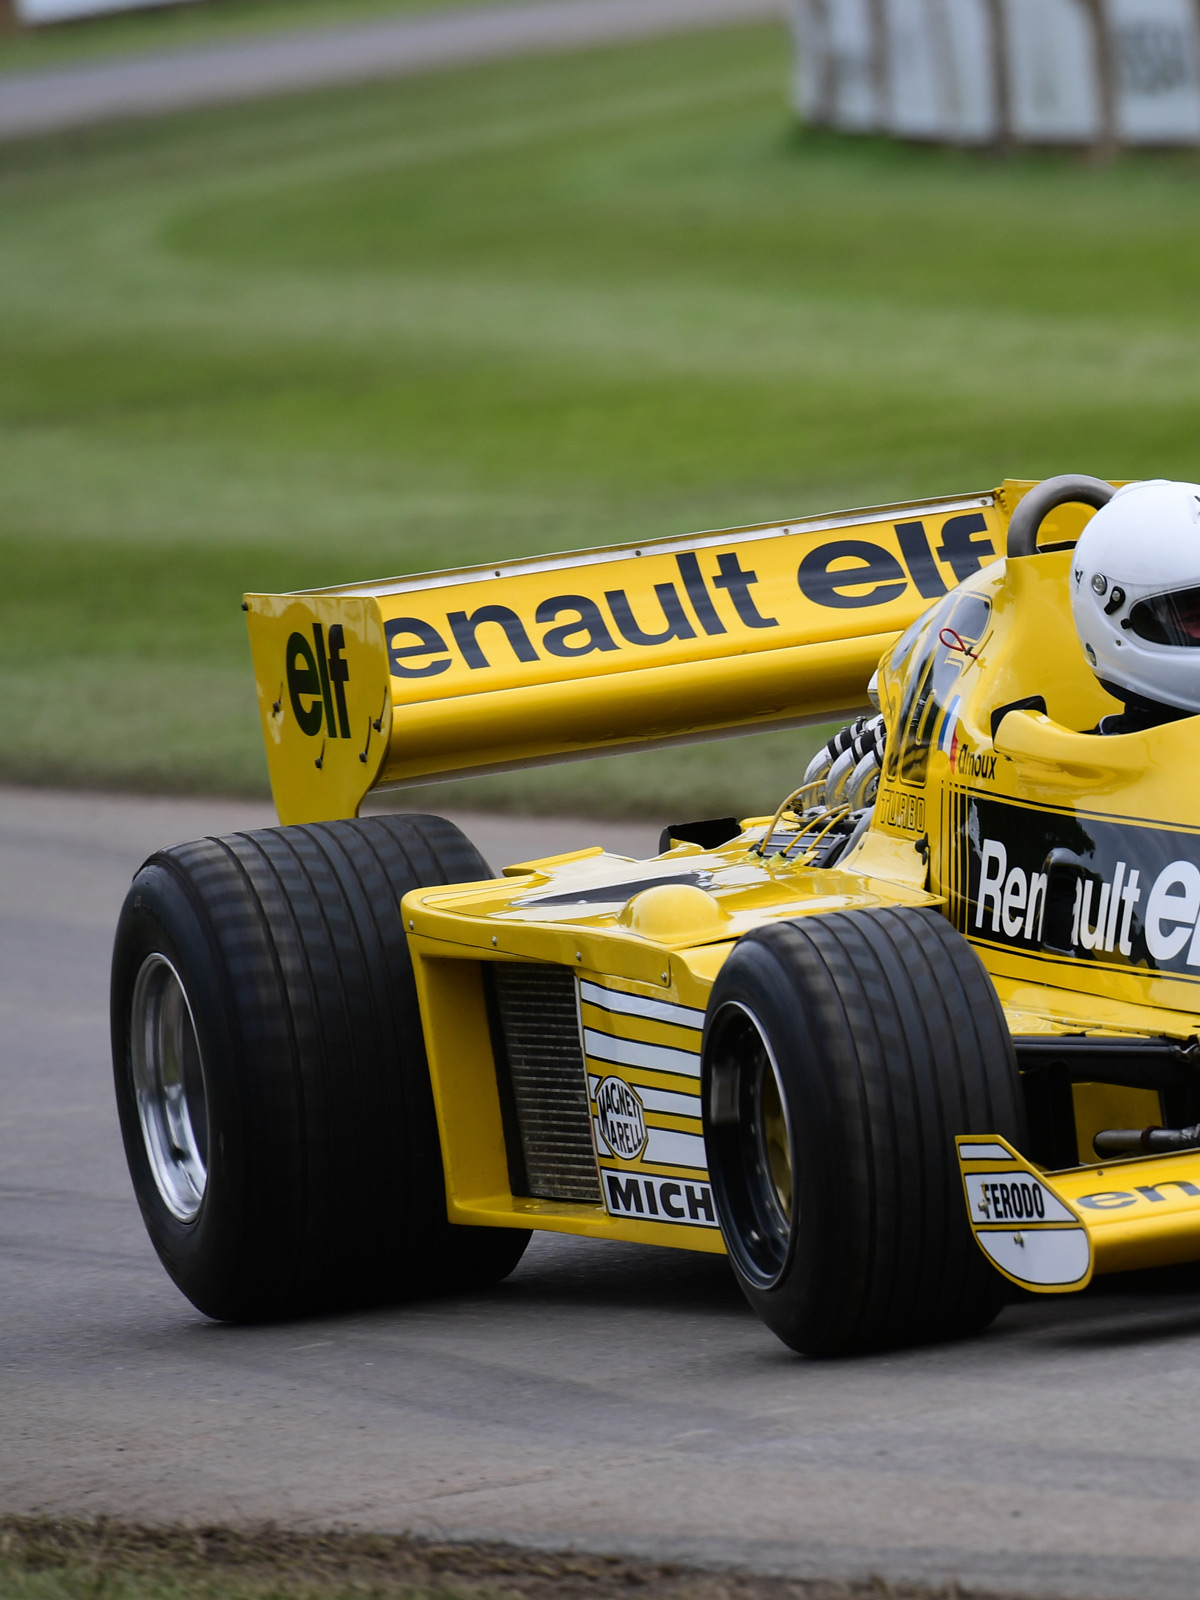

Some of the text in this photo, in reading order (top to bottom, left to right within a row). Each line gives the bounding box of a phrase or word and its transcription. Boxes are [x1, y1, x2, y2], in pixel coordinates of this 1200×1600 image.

[383, 513, 995, 678] enault elf
[286, 623, 351, 739] elf
[880, 788, 926, 833] TURBO
[607, 1175, 716, 1222] MICH
[980, 1182, 1045, 1219] FERODO
